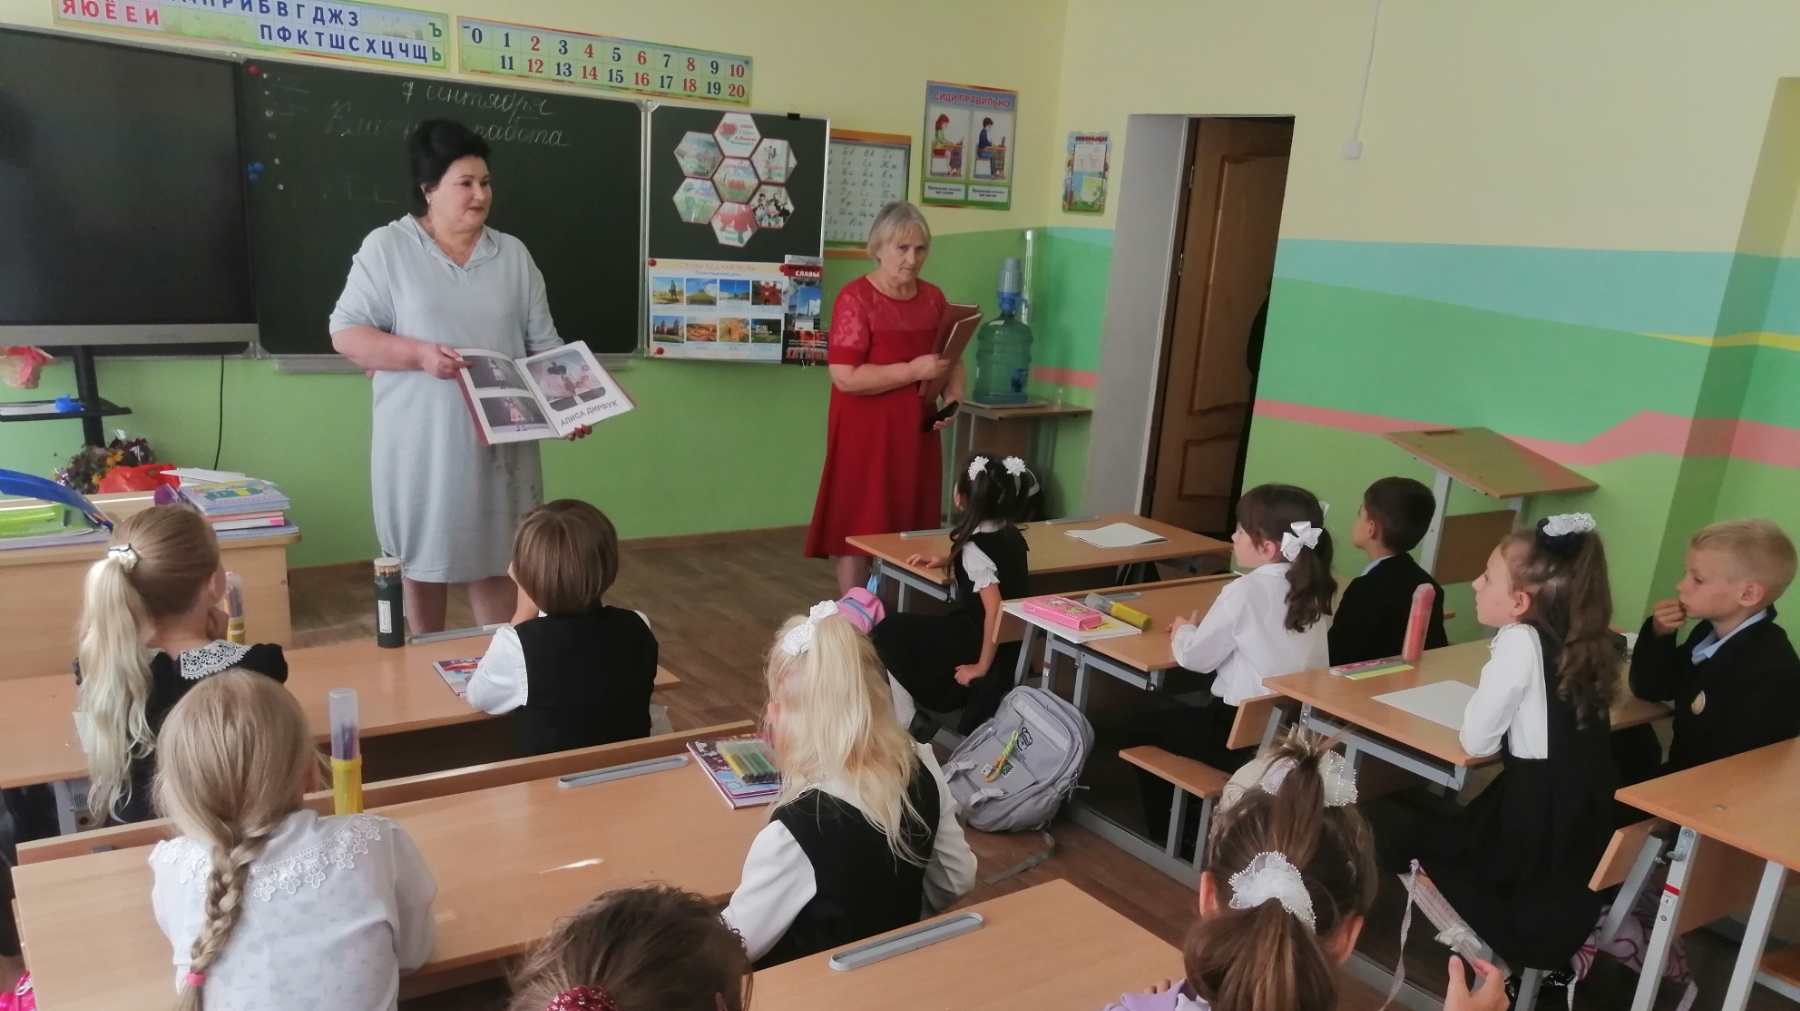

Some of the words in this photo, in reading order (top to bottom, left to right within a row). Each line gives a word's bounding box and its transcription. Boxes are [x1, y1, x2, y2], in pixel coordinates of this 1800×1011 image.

[63, 0, 76, 14] Я
[82, 0, 99, 17] Ю
[106, 0, 117, 20] Ё
[126, 6, 138, 23] Е
[145, 9, 159, 26] И
[260, 24, 272, 40] П
[277, 26, 292, 42] Ф
[297, 29, 309, 46] К
[315, 32, 325, 47] Т
[330, 34, 345, 50] Ш
[349, 36, 360, 51] С
[366, 38, 377, 54] Х
[382, 40, 394, 59] Ц
[399, 42, 409, 57] Ч
[413, 44, 427, 63] Щ
[432, 47, 442, 61] Ь
[259, 1, 271, 14] Б
[277, 1, 289, 17] В
[297, 4, 305, 19] Г
[312, 6, 325, 25] Д
[328, 8, 344, 25] Ж
[348, 12, 358, 26] З
[429, 22, 442, 38] Ъ
[472, 28, 483, 44] 0
[504, 32, 511, 48] 1
[530, 36, 541, 52] 2
[558, 40, 568, 55] 3
[584, 44, 594, 58] 4
[612, 47, 621, 62] 5
[638, 51, 647, 65] 6
[663, 54, 671, 68] 7
[687, 57, 696, 72] 8
[710, 60, 719, 75] 9
[730, 64, 745, 78] 10
[402, 81, 415, 104] 7
[501, 55, 515, 70] 11
[528, 58, 544, 74] 12
[556, 62, 572, 77] 13
[582, 65, 598, 80] 14
[608, 68, 624, 83] 15
[634, 72, 650, 87] 16
[660, 75, 674, 89] 17
[682, 78, 697, 93] 18
[706, 81, 721, 95] 19
[728, 84, 745, 98] 20
[934, 92, 958, 103] СИДИ
[960, 94, 1011, 108] ПРАВИЛЬНО
[795, 270, 820, 278] СЛАВЫ
[560, 411, 586, 427] АЛИСА
[586, 400, 618, 417] ДИРВУК
